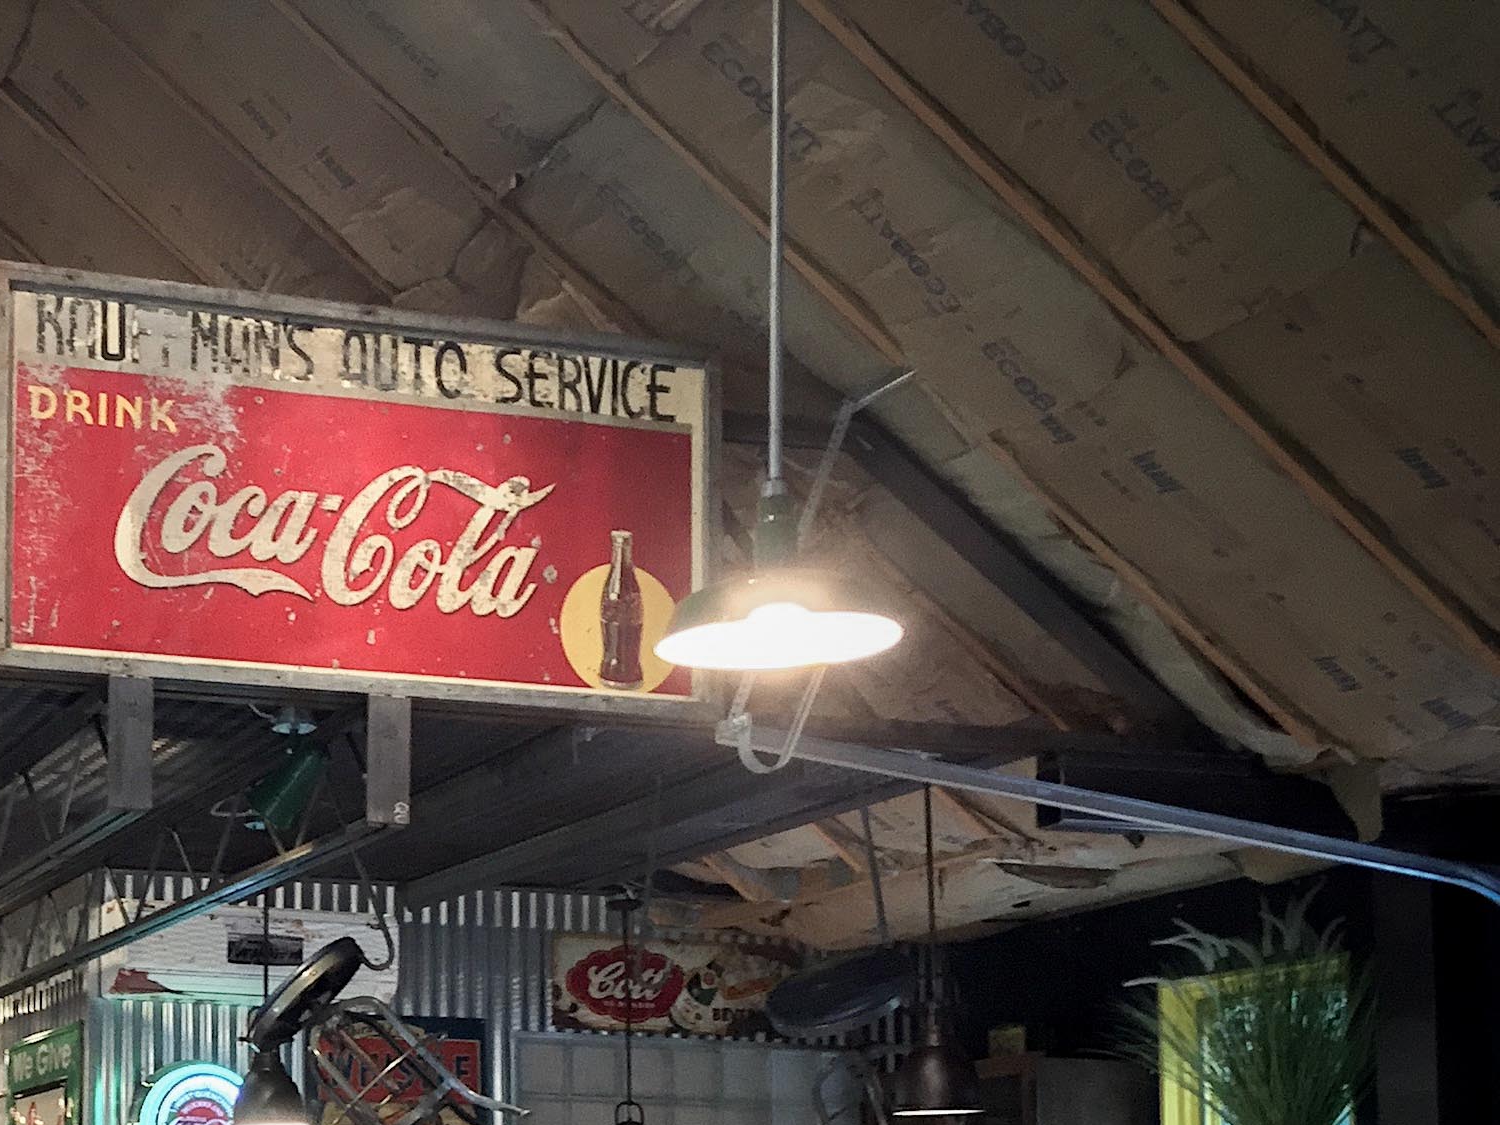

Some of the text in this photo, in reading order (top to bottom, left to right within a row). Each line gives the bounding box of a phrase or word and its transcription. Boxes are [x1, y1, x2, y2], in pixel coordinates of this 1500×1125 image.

[27, 383, 178, 434] DRINK
[341, 328, 470, 400] AUTO
[493, 348, 678, 423] SERVICE
[113, 444, 557, 621] Coca-Cola
[12, 1041, 73, 1083] We Give
